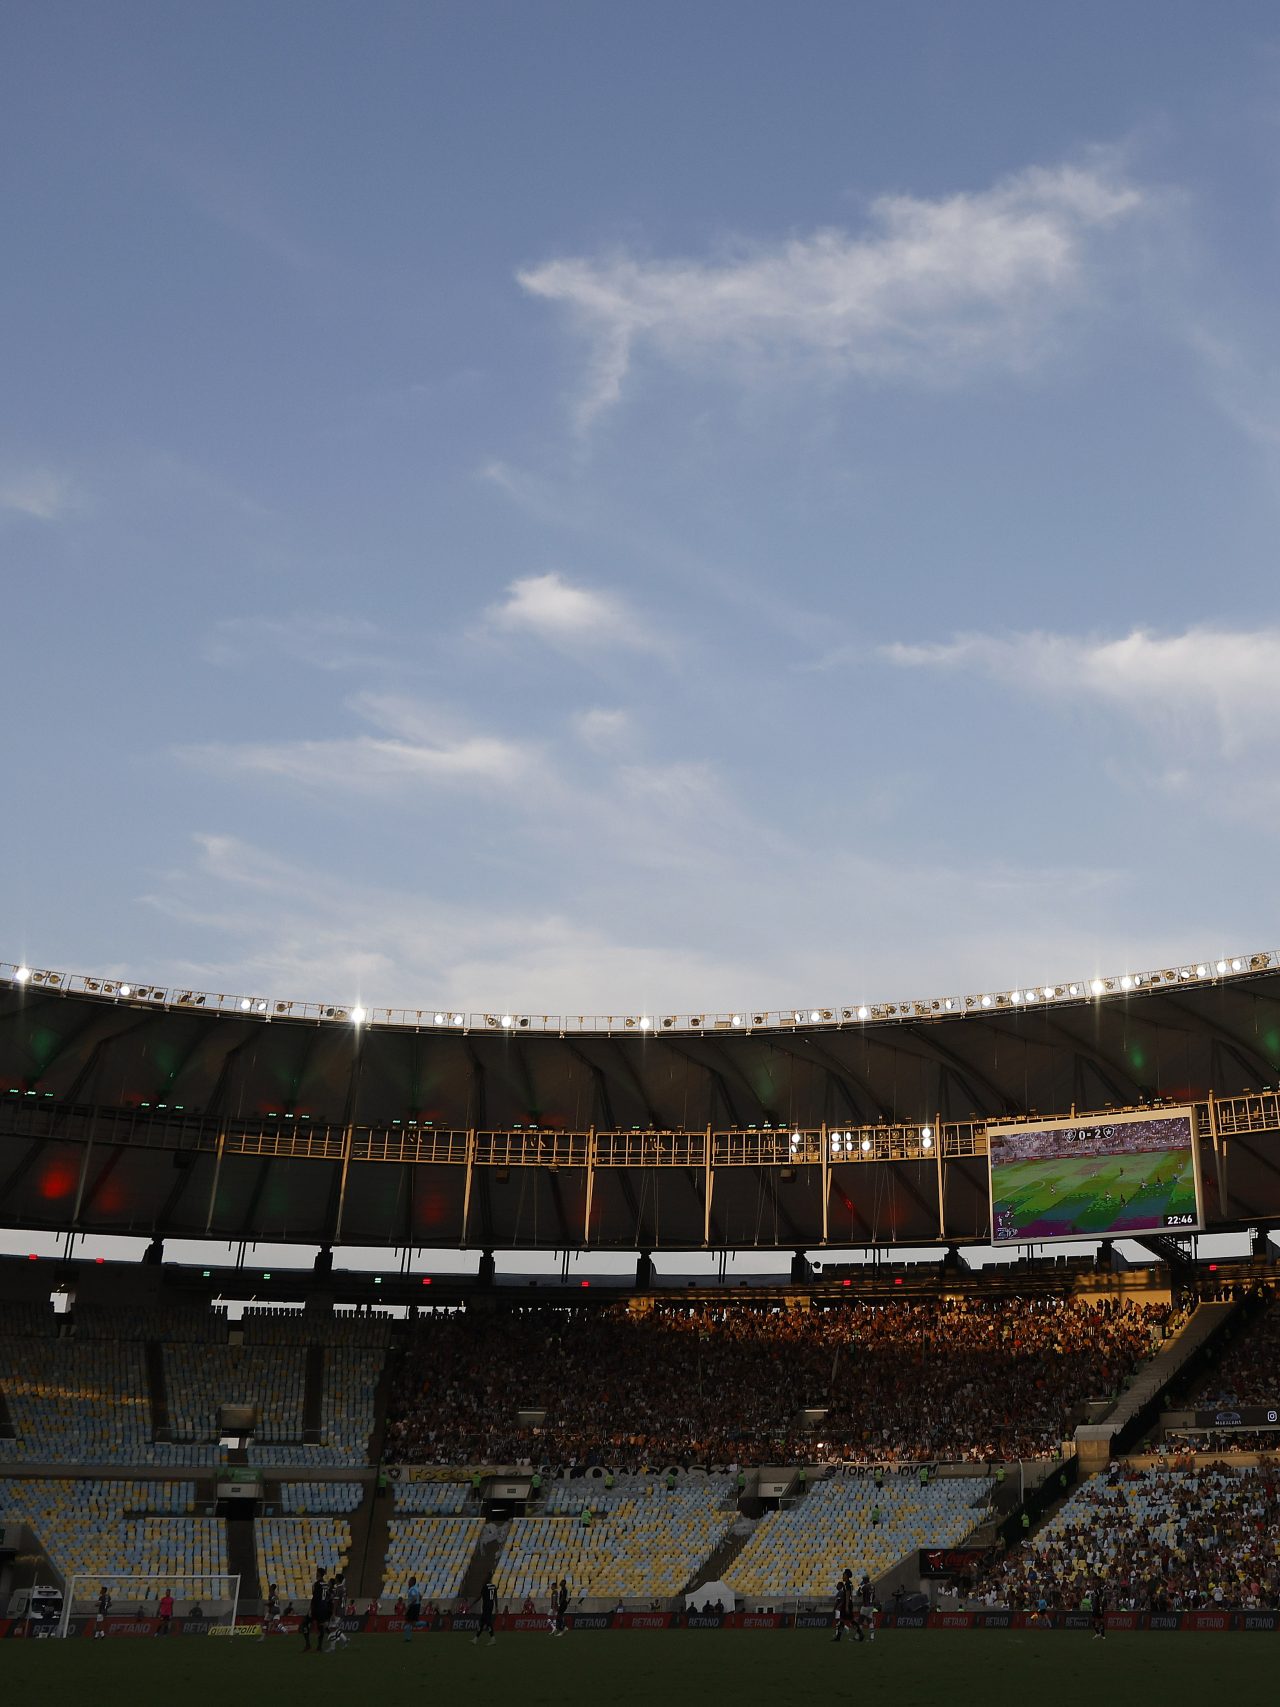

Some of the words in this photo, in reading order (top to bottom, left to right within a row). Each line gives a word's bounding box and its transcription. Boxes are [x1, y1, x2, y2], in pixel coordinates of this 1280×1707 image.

[1078, 1130, 1086, 1141] 0
[1094, 1128, 1102, 1139] 2
[1167, 1214, 1193, 1225] 22:46
[574, 1617, 607, 1628] BETANO
[631, 1617, 664, 1628] BETANO
[687, 1617, 719, 1628] BETANO
[743, 1617, 774, 1628] BETANO
[896, 1616, 924, 1627] BETANO
[984, 1616, 1009, 1627] BETANO
[1151, 1617, 1177, 1629] BETANO
[1197, 1617, 1224, 1629] BETANO
[1246, 1617, 1274, 1629] BETANO
